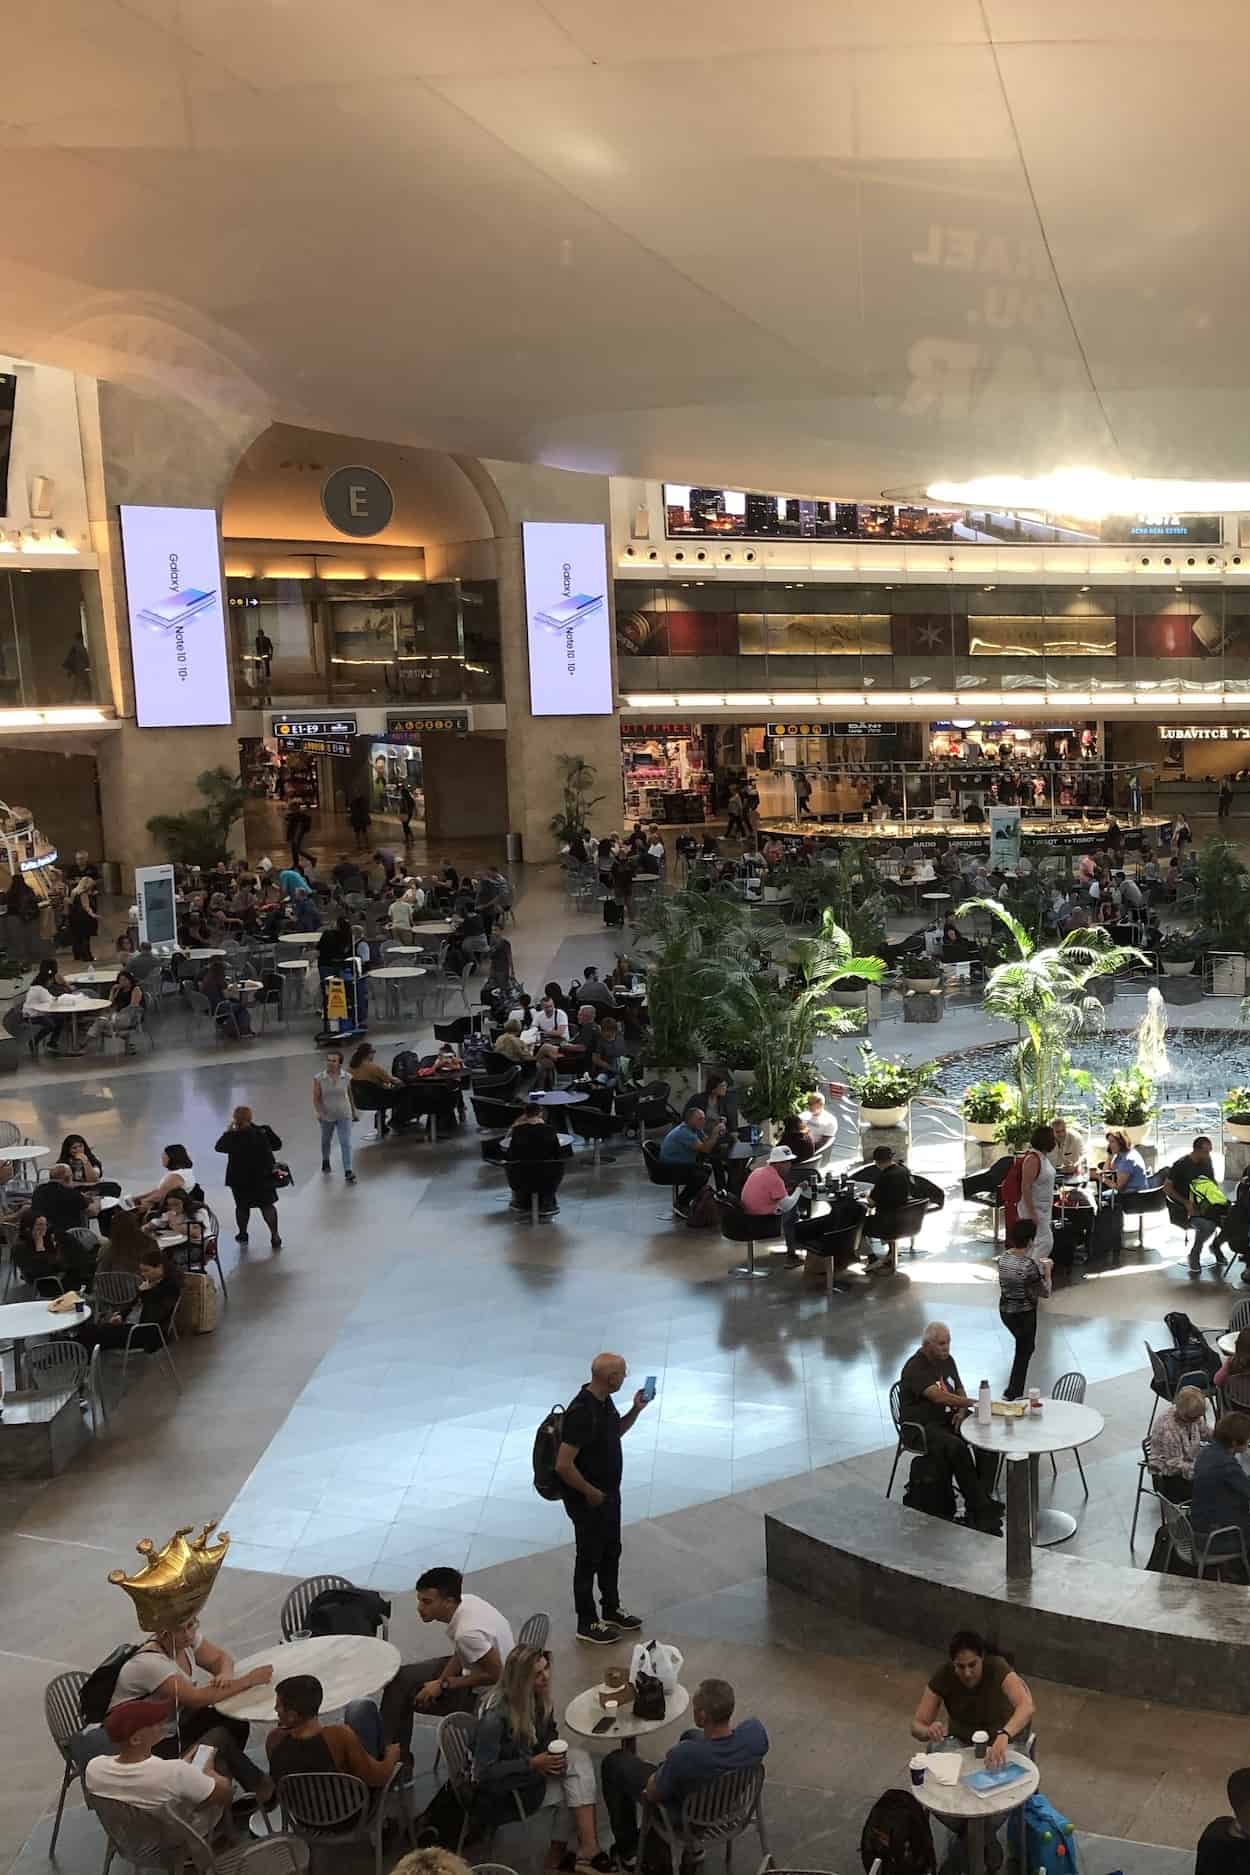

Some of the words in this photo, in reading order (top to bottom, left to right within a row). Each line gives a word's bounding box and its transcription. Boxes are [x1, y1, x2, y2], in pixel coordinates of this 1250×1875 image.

[351, 486, 368, 516] E
[168, 553, 180, 592] Galaxy
[562, 563, 571, 597] Galaxy
[1159, 726, 1228, 739] LUBAVITCH
